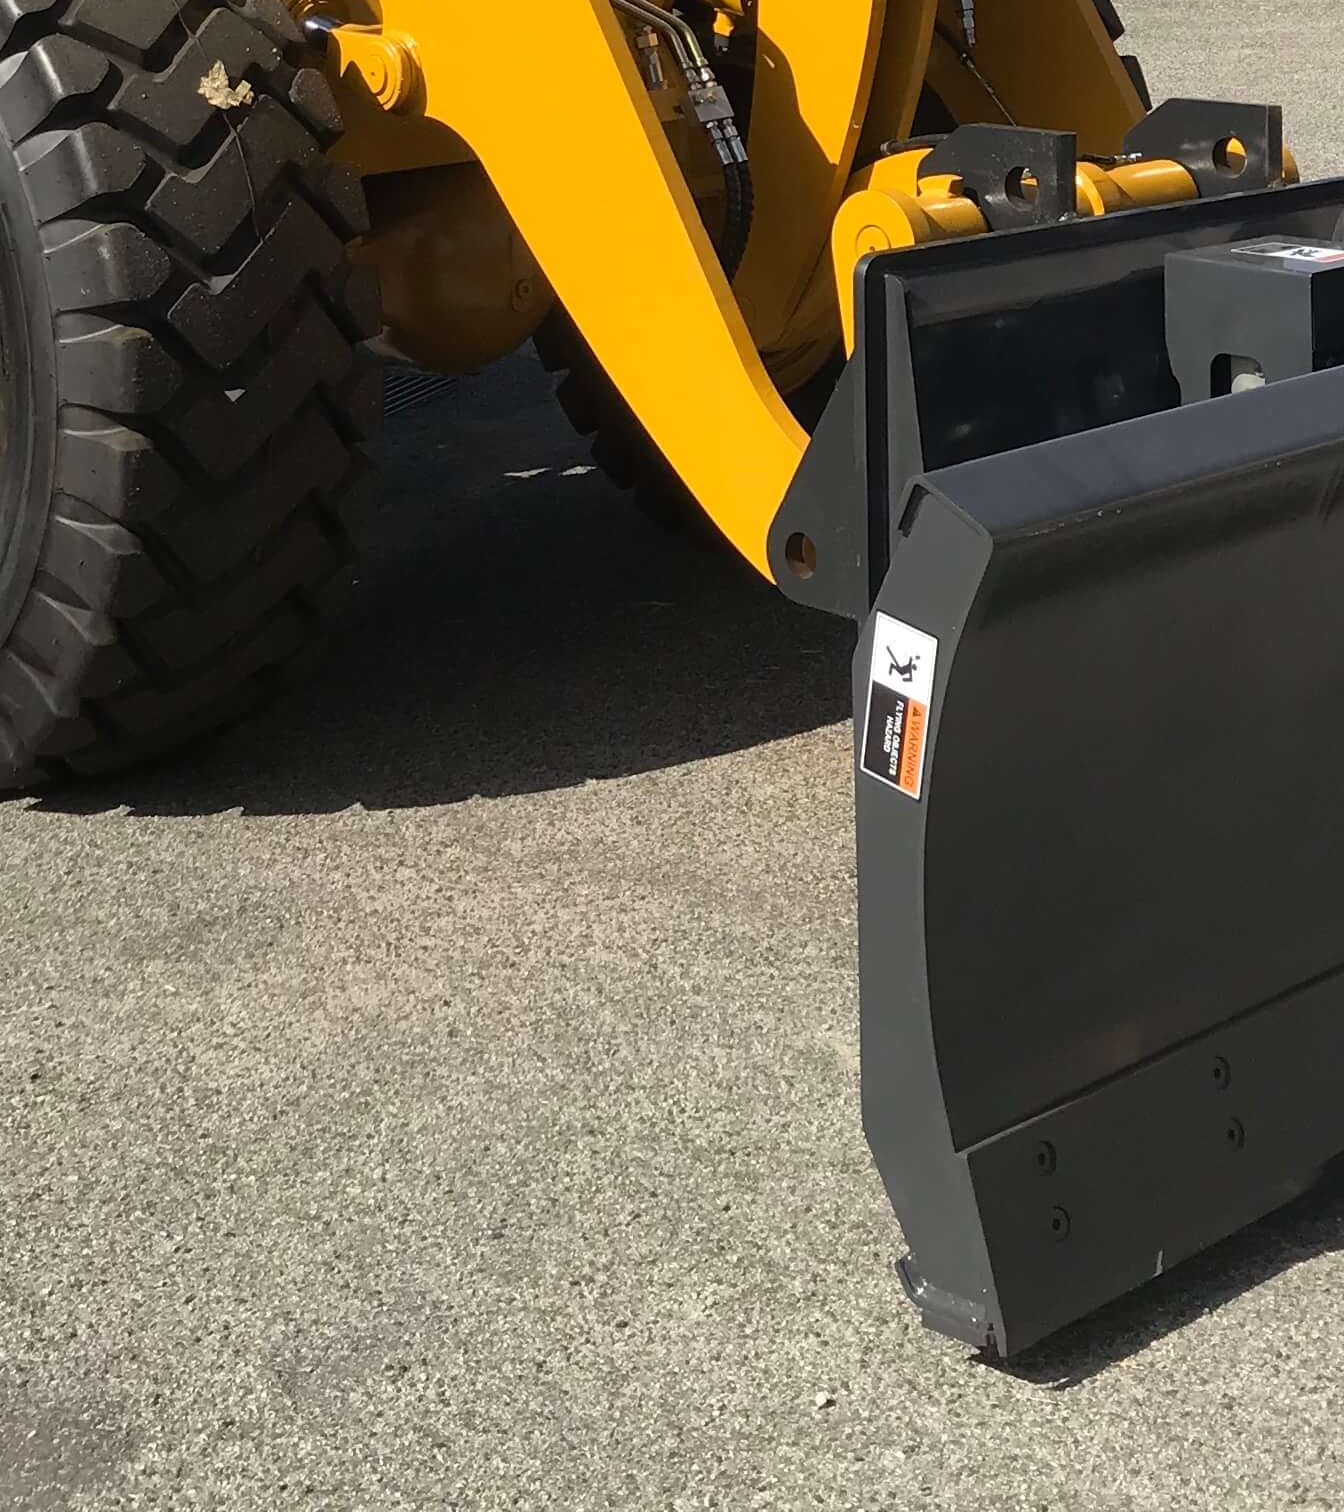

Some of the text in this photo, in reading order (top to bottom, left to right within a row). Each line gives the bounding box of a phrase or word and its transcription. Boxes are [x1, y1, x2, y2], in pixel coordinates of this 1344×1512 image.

[883, 715, 894, 753] HAZARD
[889, 700, 905, 776] FLYING OBJECTS
[905, 721, 921, 787] WARNING
